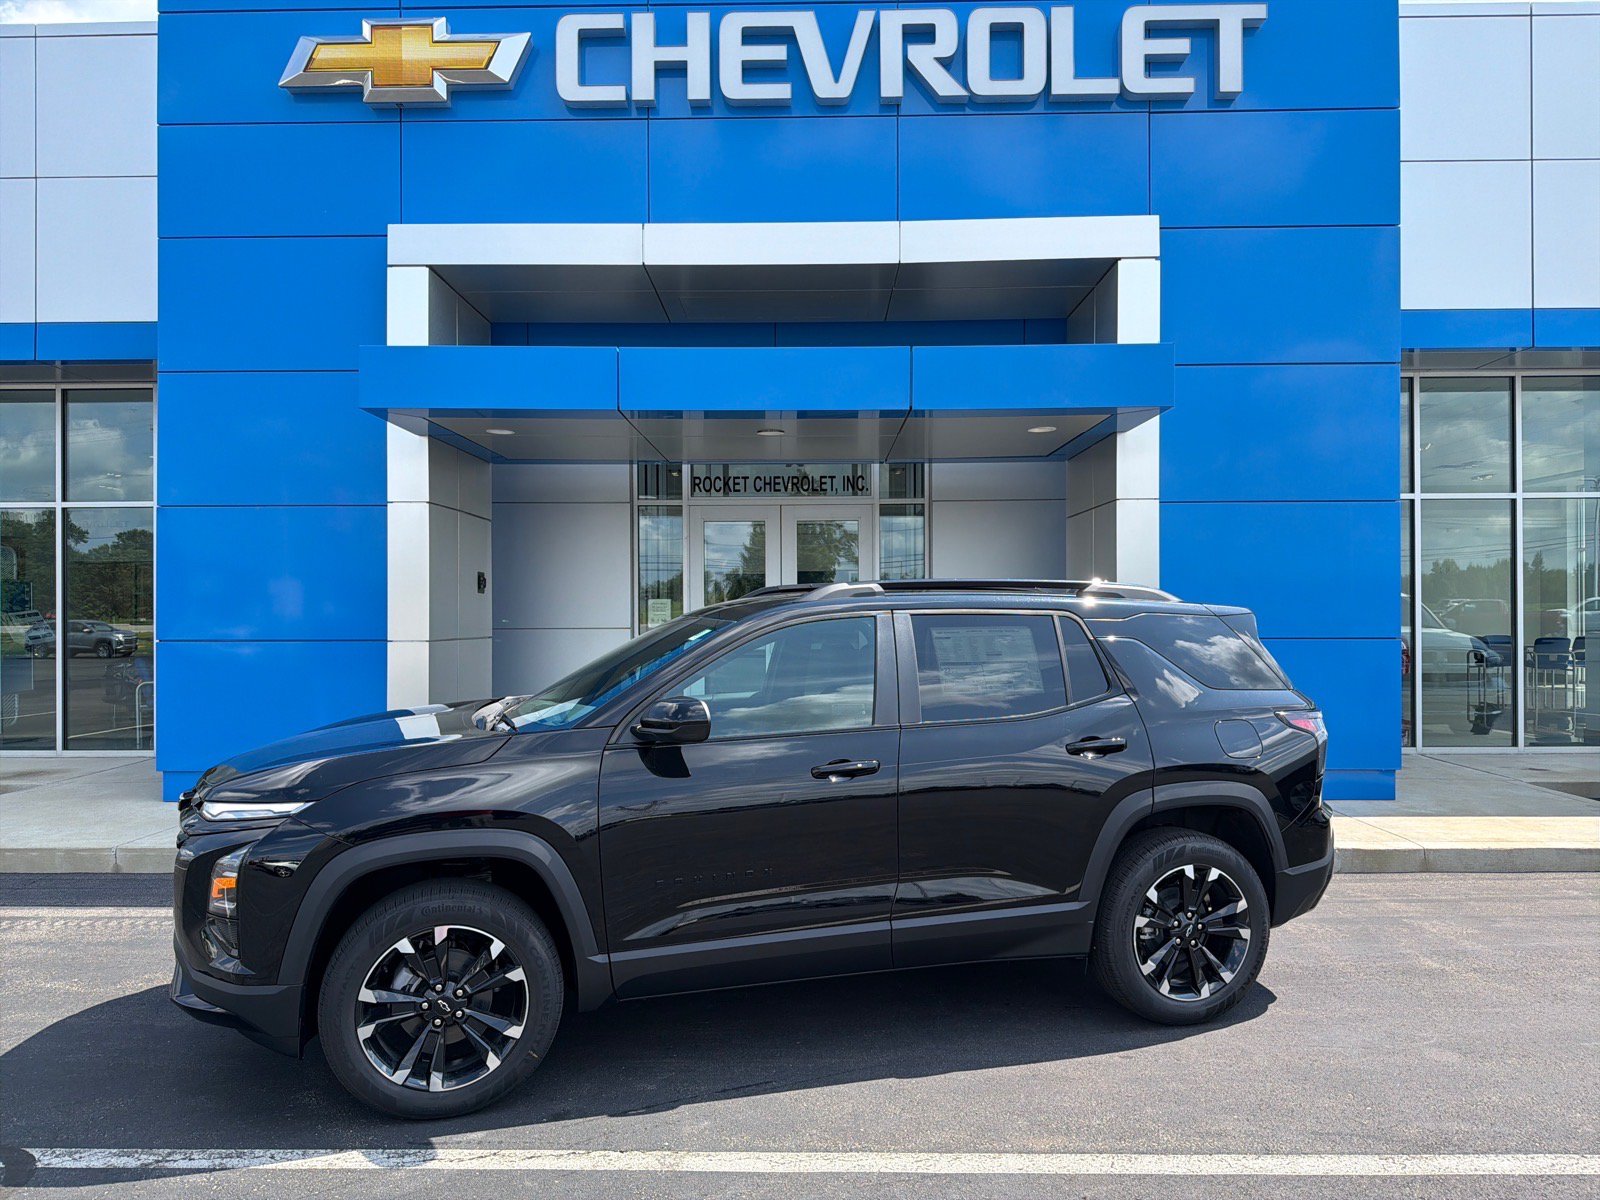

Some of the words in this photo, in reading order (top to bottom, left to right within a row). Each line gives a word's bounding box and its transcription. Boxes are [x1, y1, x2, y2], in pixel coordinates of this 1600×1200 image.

[555, 4, 1268, 104] CHEVROLET
[693, 476, 749, 493] ROCKET
[753, 475, 838, 494] CHEVROLET,
[842, 475, 869, 492] INC.
